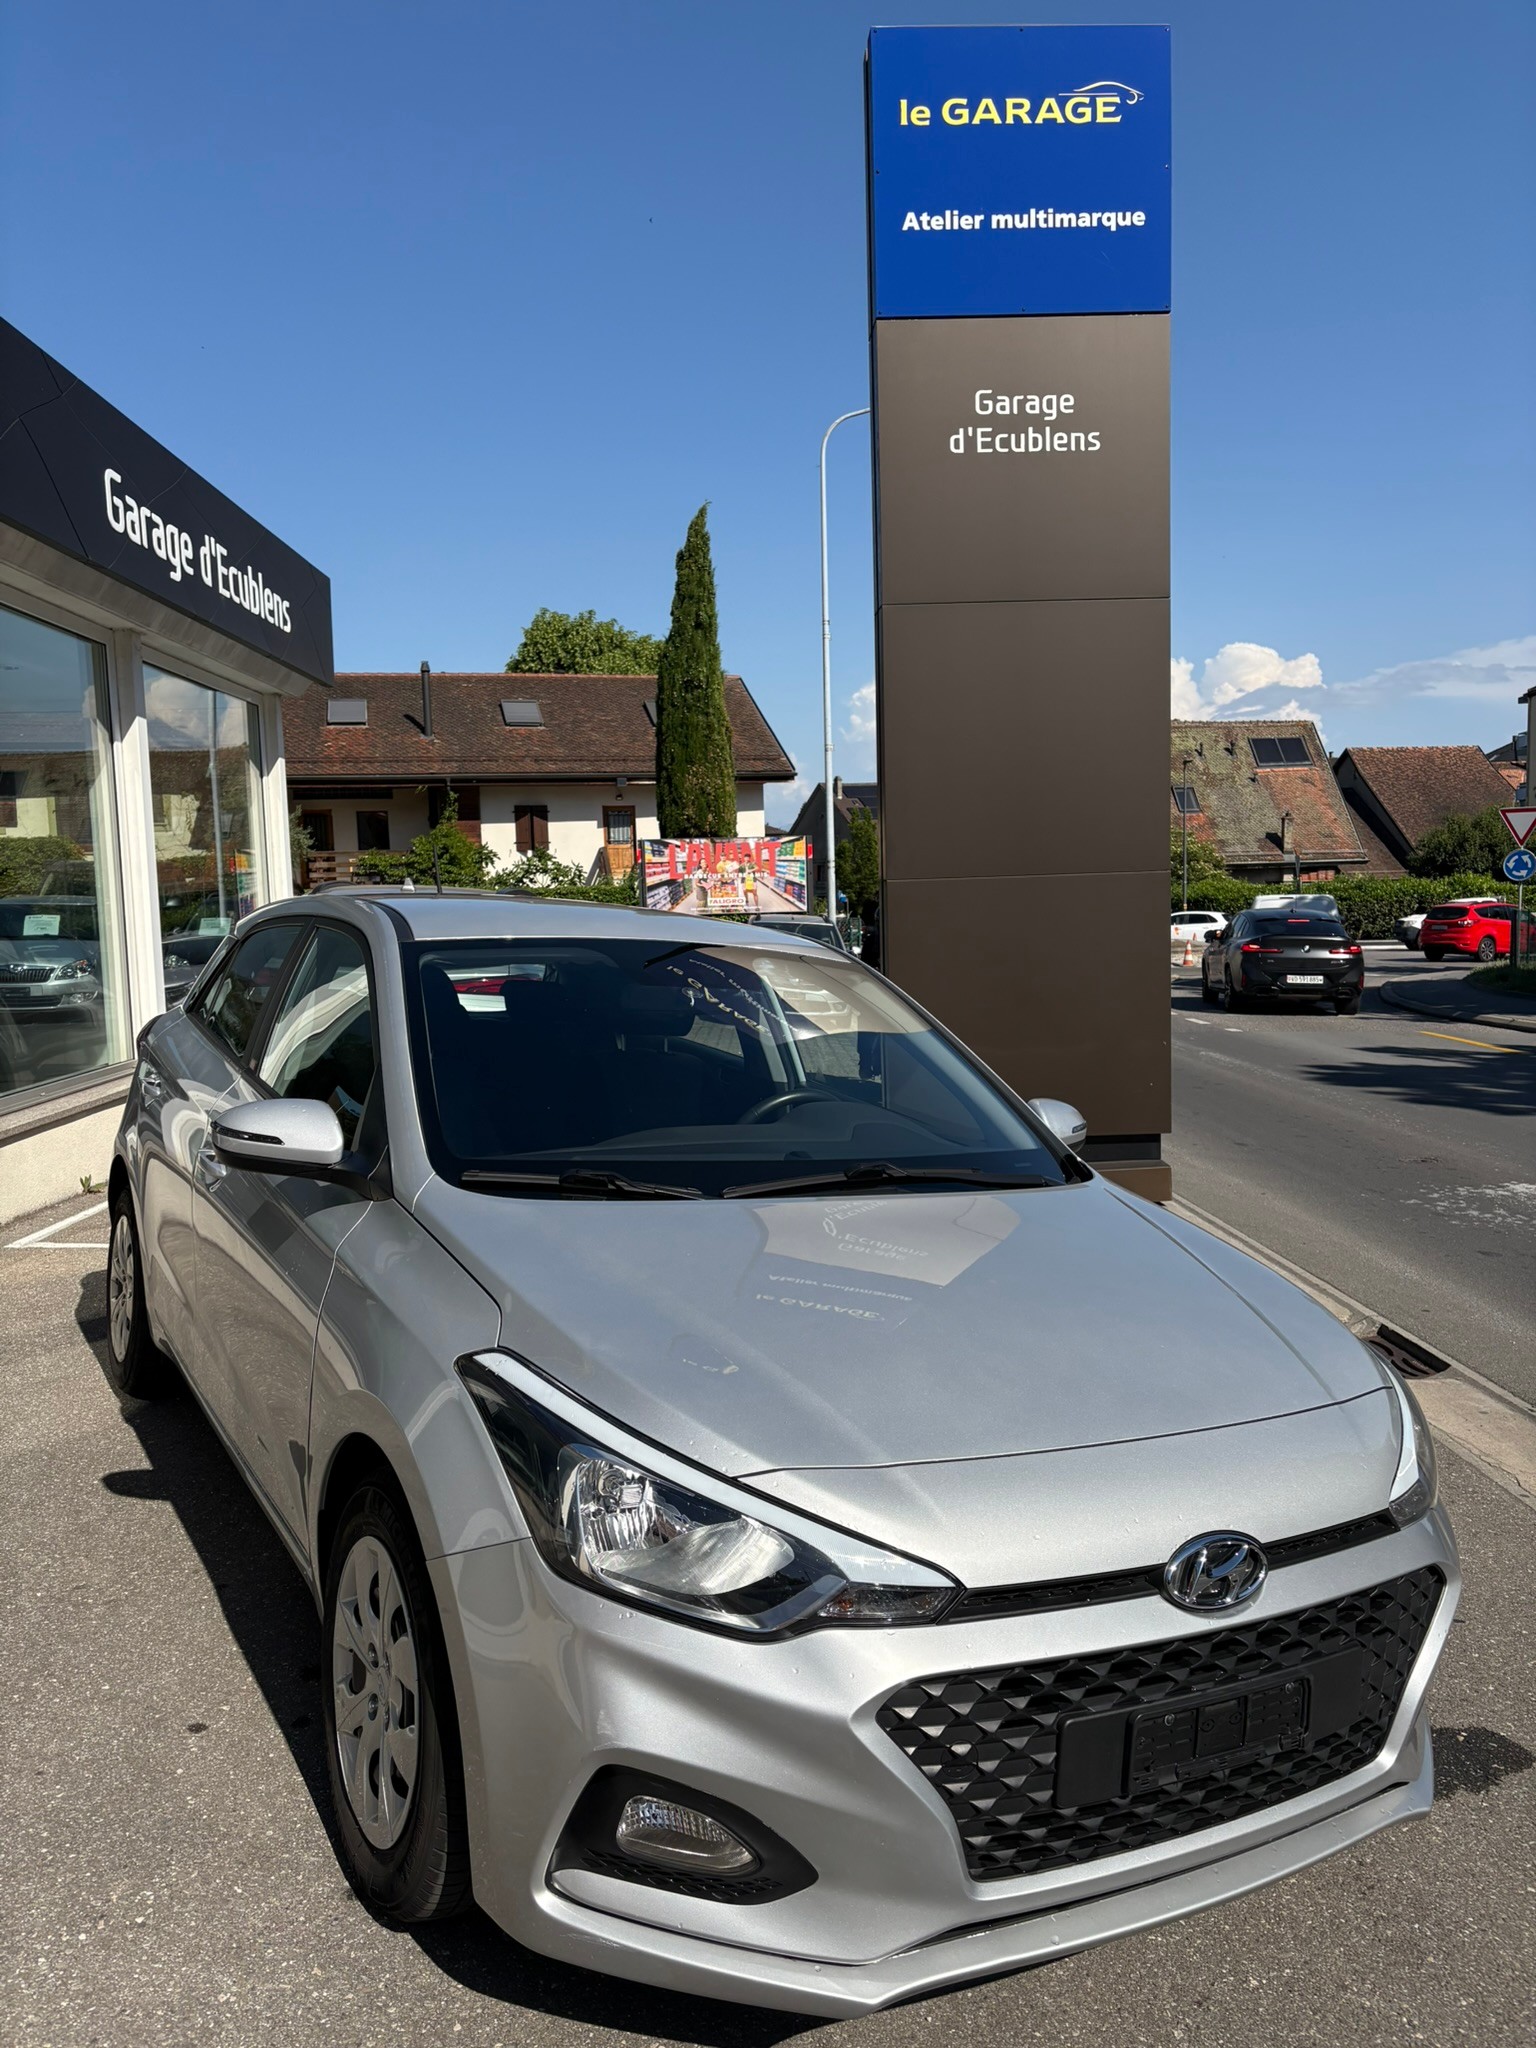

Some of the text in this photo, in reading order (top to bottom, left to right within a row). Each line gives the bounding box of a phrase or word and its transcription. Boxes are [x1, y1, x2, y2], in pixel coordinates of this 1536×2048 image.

[899, 96, 1122, 126] le GARAGE
[902, 207, 1146, 232] Atelier multimarque
[974, 389, 1075, 421] Garage
[949, 426, 1101, 454] d'Ecublens
[104, 468, 292, 634] Garage d'Ecublens
